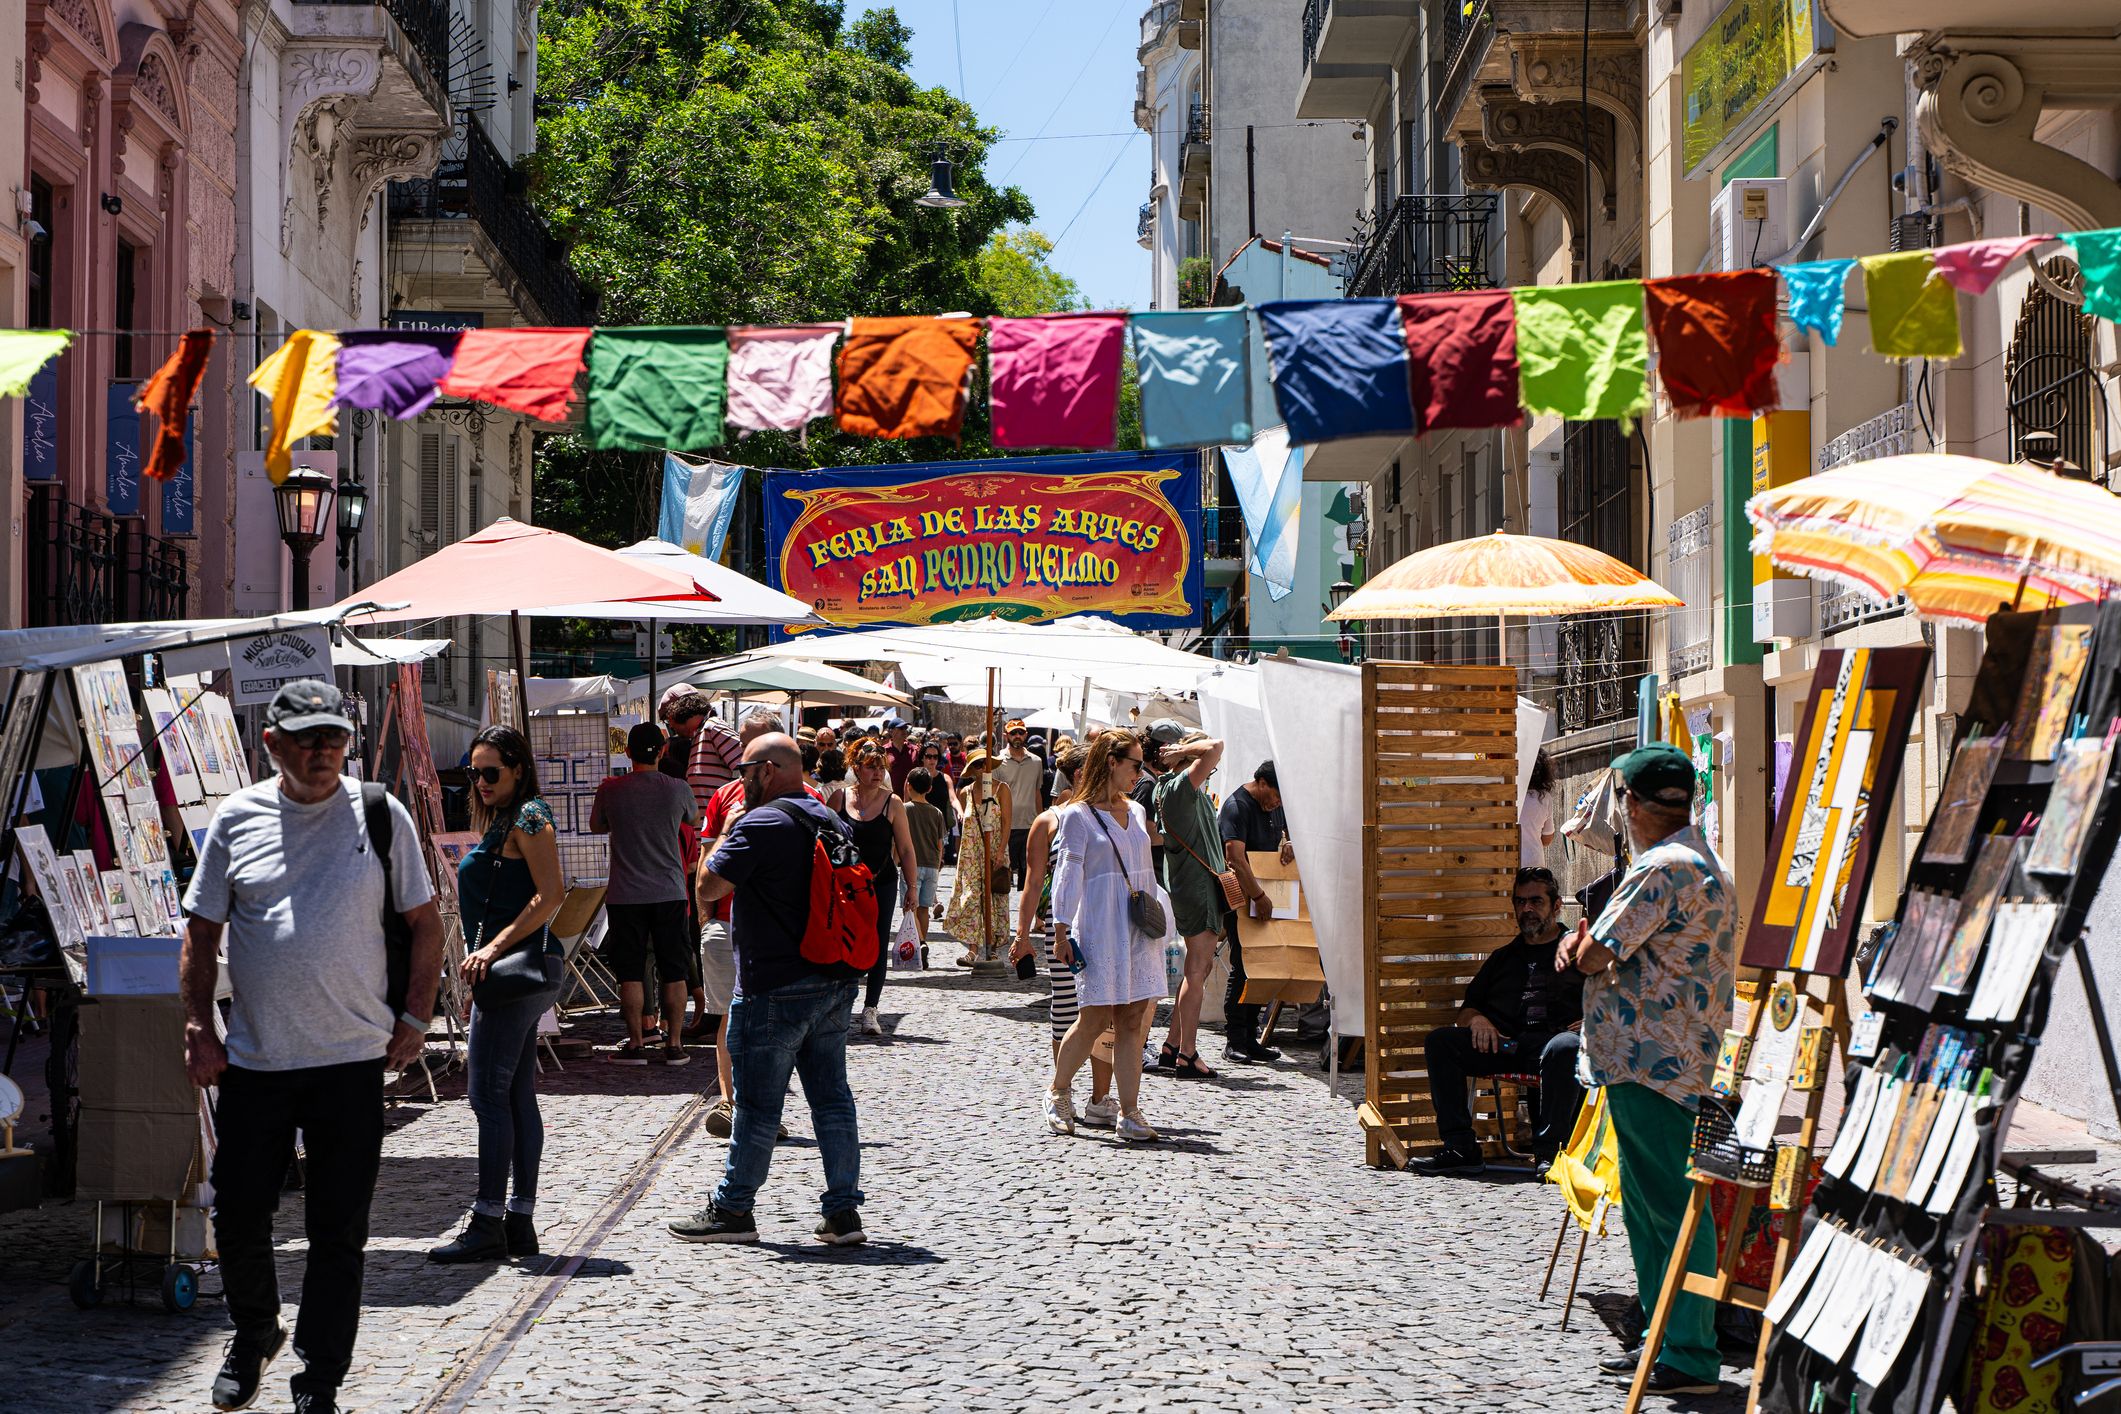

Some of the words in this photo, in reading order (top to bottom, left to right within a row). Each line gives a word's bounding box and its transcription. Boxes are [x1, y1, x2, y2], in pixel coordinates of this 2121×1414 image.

[30, 398, 56, 463] Amelia
[115, 441, 138, 500] Amelia
[807, 516, 917, 569] FERIA
[919, 506, 969, 538] DE
[973, 504, 1043, 534] LAS
[1048, 507, 1165, 552] ARTES
[859, 555, 919, 600] SAN
[922, 541, 1017, 593] PEDRO
[1022, 541, 1121, 588] TELMO
[958, 606, 985, 619] desde
[242, 634, 274, 664] MUSEO
[280, 633, 317, 659] CIUDAD
